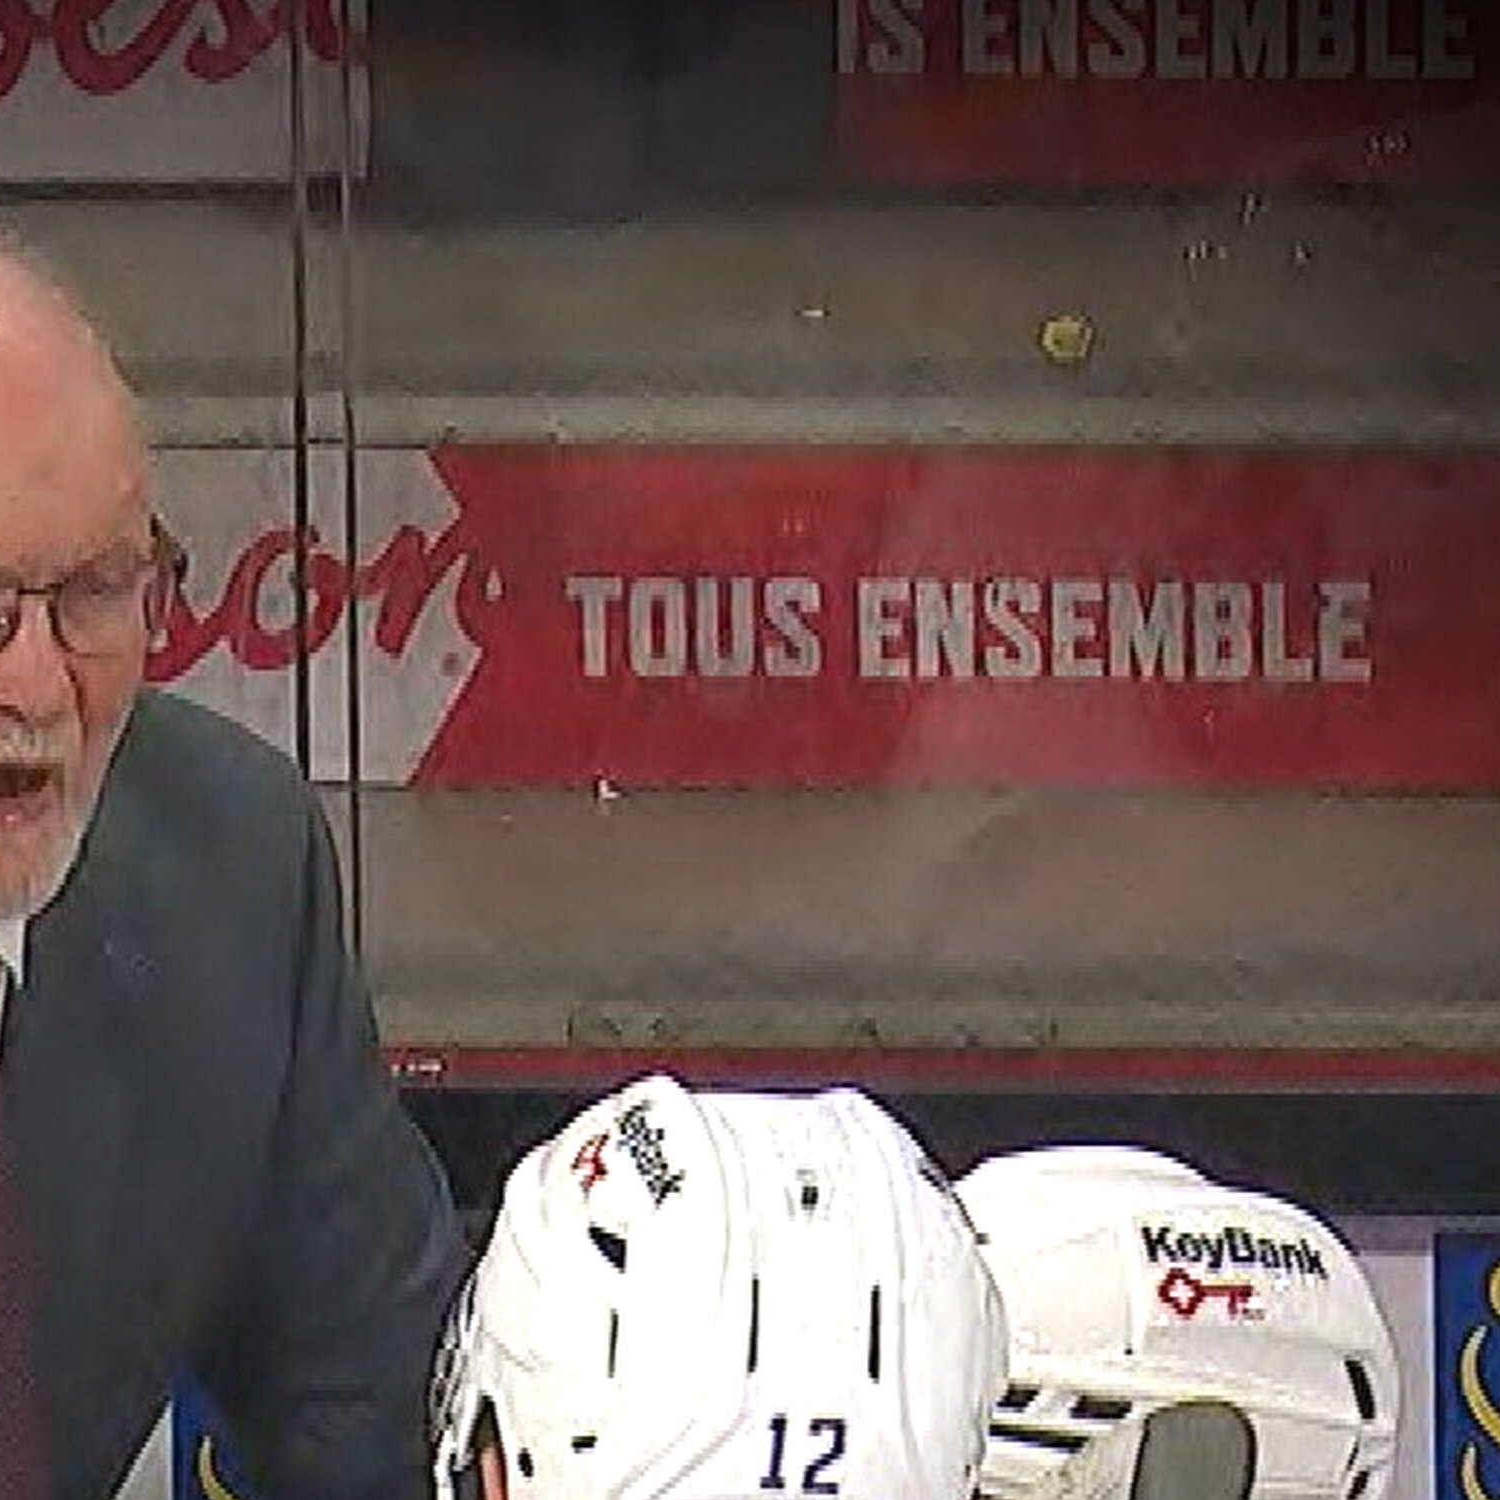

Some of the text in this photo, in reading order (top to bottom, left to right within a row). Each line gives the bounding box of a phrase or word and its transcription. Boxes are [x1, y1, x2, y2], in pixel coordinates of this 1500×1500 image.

[564, 575, 1373, 684] TOUS ENSEMBLE
[759, 1412, 847, 1496] 12
